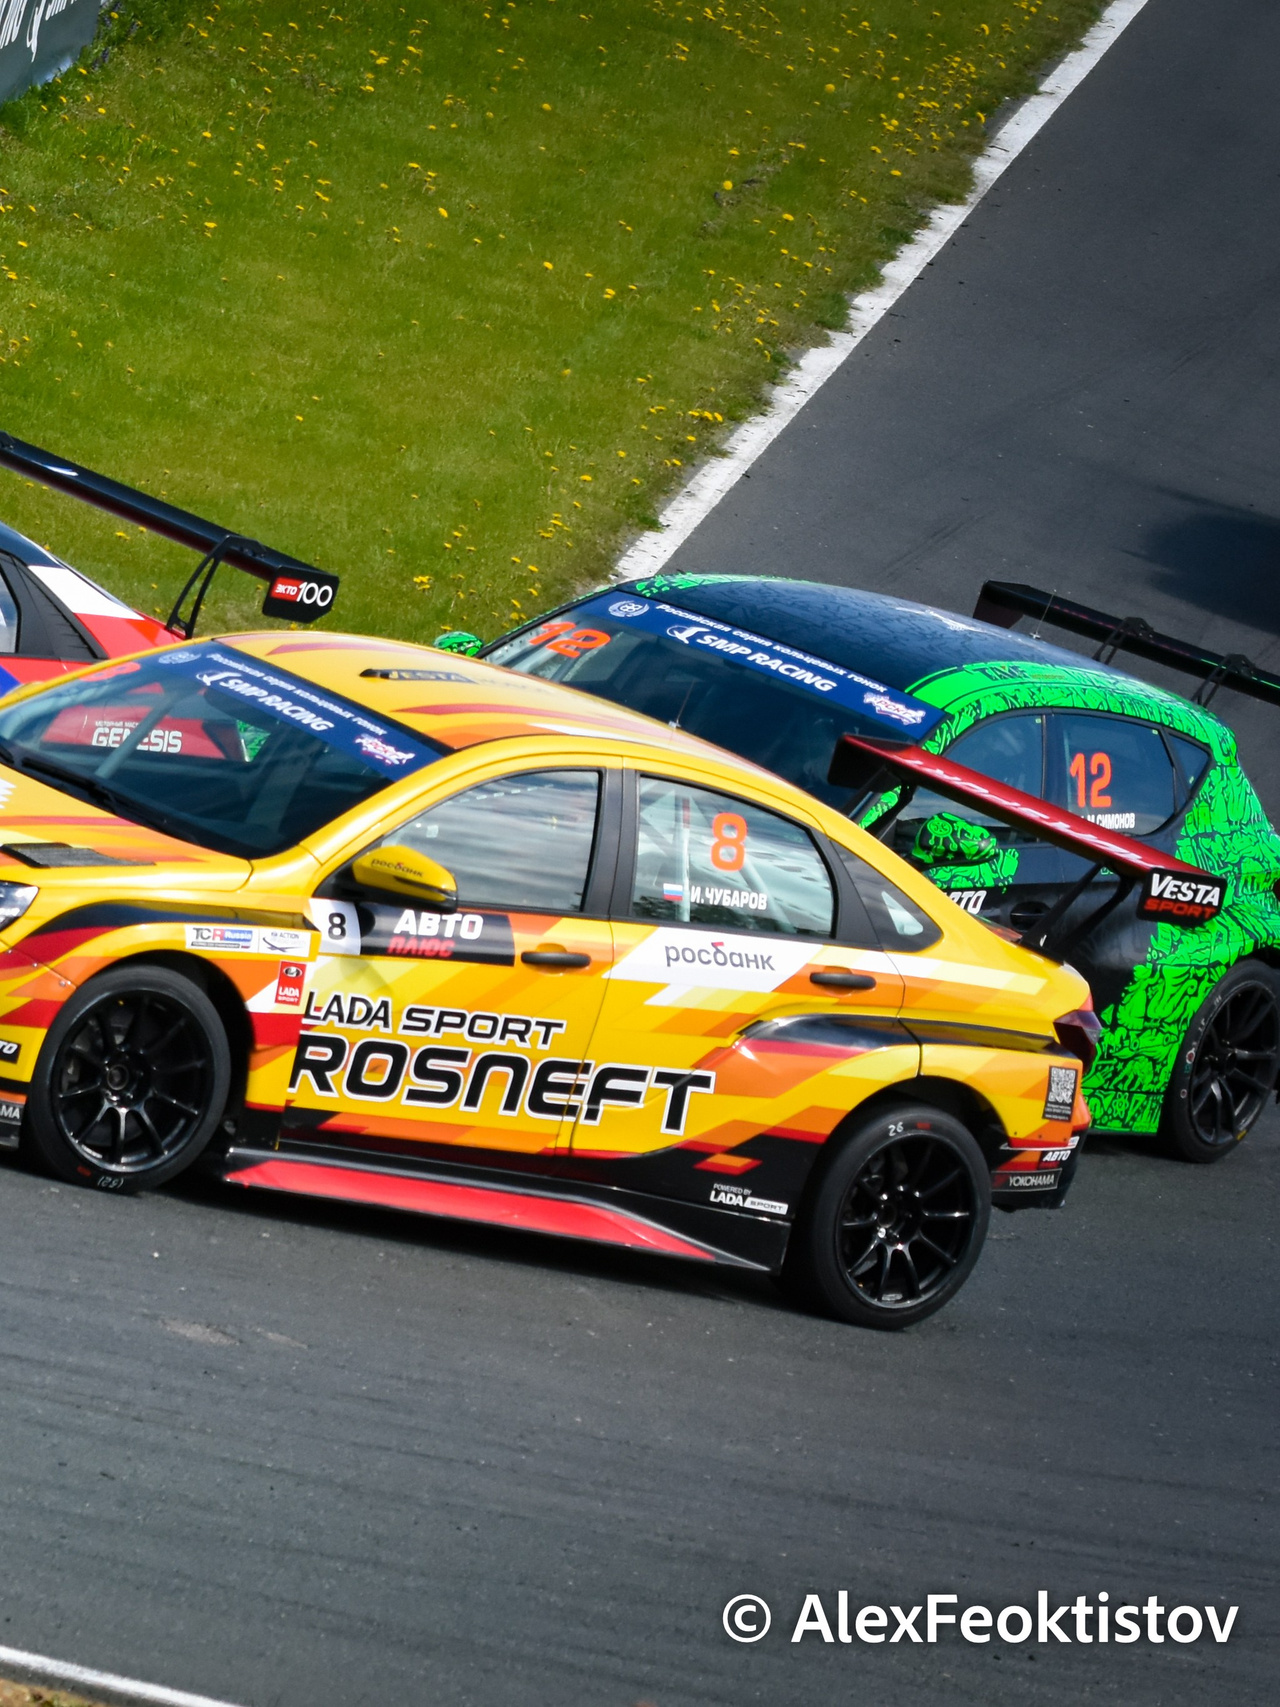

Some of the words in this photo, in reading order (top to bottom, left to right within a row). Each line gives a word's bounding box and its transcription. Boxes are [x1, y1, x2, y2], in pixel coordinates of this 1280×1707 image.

[296, 582, 333, 607] 100
[529, 621, 611, 658] 12
[656, 604, 731, 632] Российская
[732, 630, 773, 647] серия
[847, 674, 888, 693] гонок
[696, 635, 752, 655] SMP
[747, 652, 837, 691] RACING
[220, 677, 268, 698] SMP
[258, 694, 334, 731] RACING
[1070, 752, 1112, 808] 12
[710, 812, 748, 872] 8
[371, 858, 423, 878] росбанк
[690, 885, 768, 910] И.ЧУБАРОВ
[1151, 873, 1220, 907] VESTA
[1144, 899, 1216, 919] SPORT
[328, 912, 346, 940] 8
[394, 909, 483, 940] АВТО
[665, 941, 776, 971] росбанк
[279, 986, 299, 997] LADA
[303, 990, 390, 1029] LADA
[402, 1007, 565, 1050] SPORT
[288, 1032, 715, 1135] ROSNEFT
[888, 1122, 904, 1137] 26
[713, 1183, 743, 1194] POWERED
[1009, 1174, 1055, 1186] YOKOHAMA
[710, 1190, 744, 1207] LADA
[750, 1200, 783, 1211] SPORT
